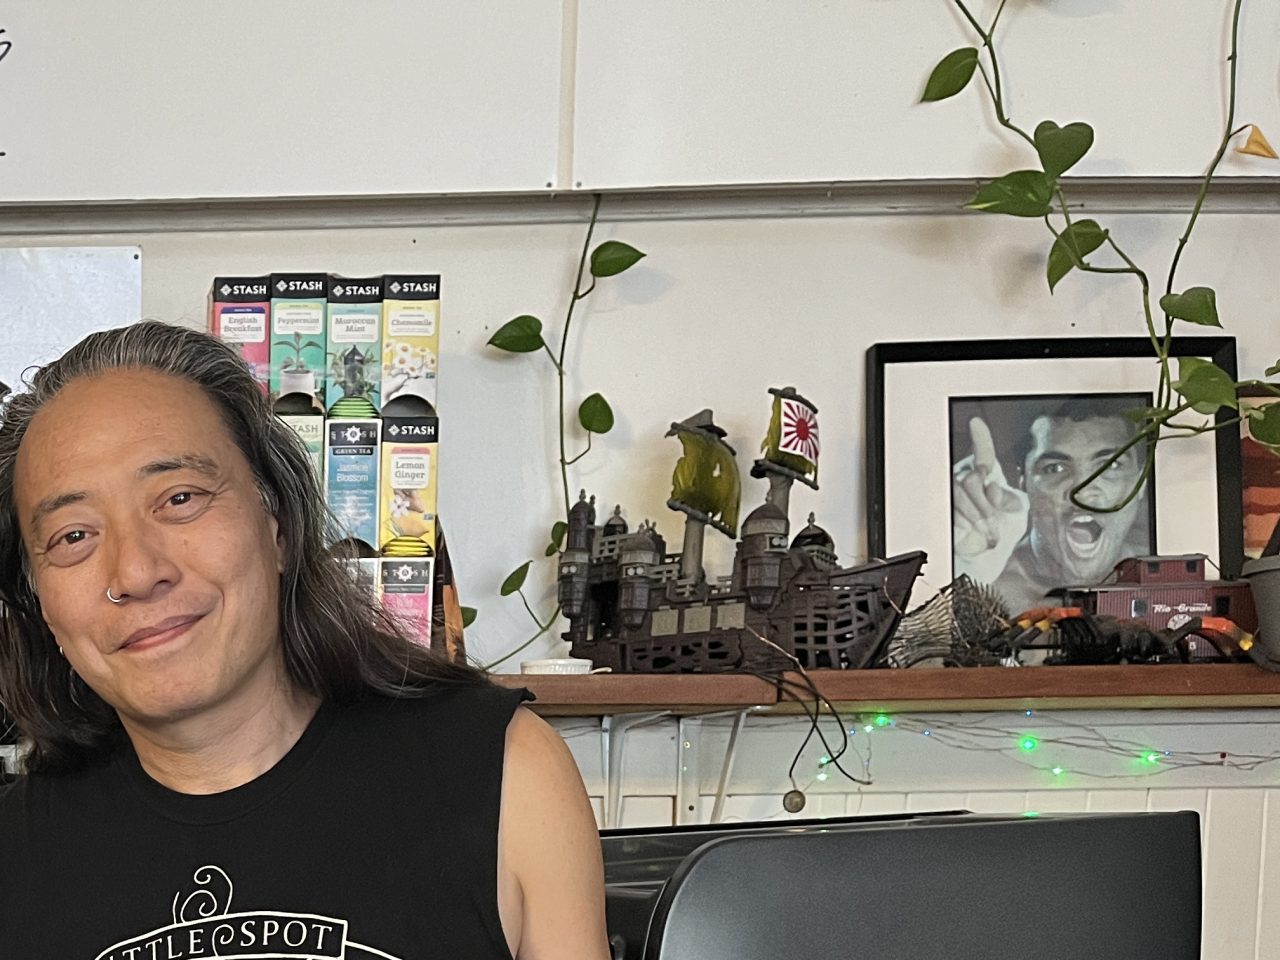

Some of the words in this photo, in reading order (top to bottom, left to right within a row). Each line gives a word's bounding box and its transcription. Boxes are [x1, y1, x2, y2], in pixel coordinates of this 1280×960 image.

[233, 285, 267, 295] STASH
[288, 281, 323, 291] STASH
[345, 285, 380, 296] STASH
[402, 282, 437, 293] STASH
[291, 424, 319, 433] TASH
[401, 425, 435, 435] STASH
[240, 920, 333, 950] SPOT
